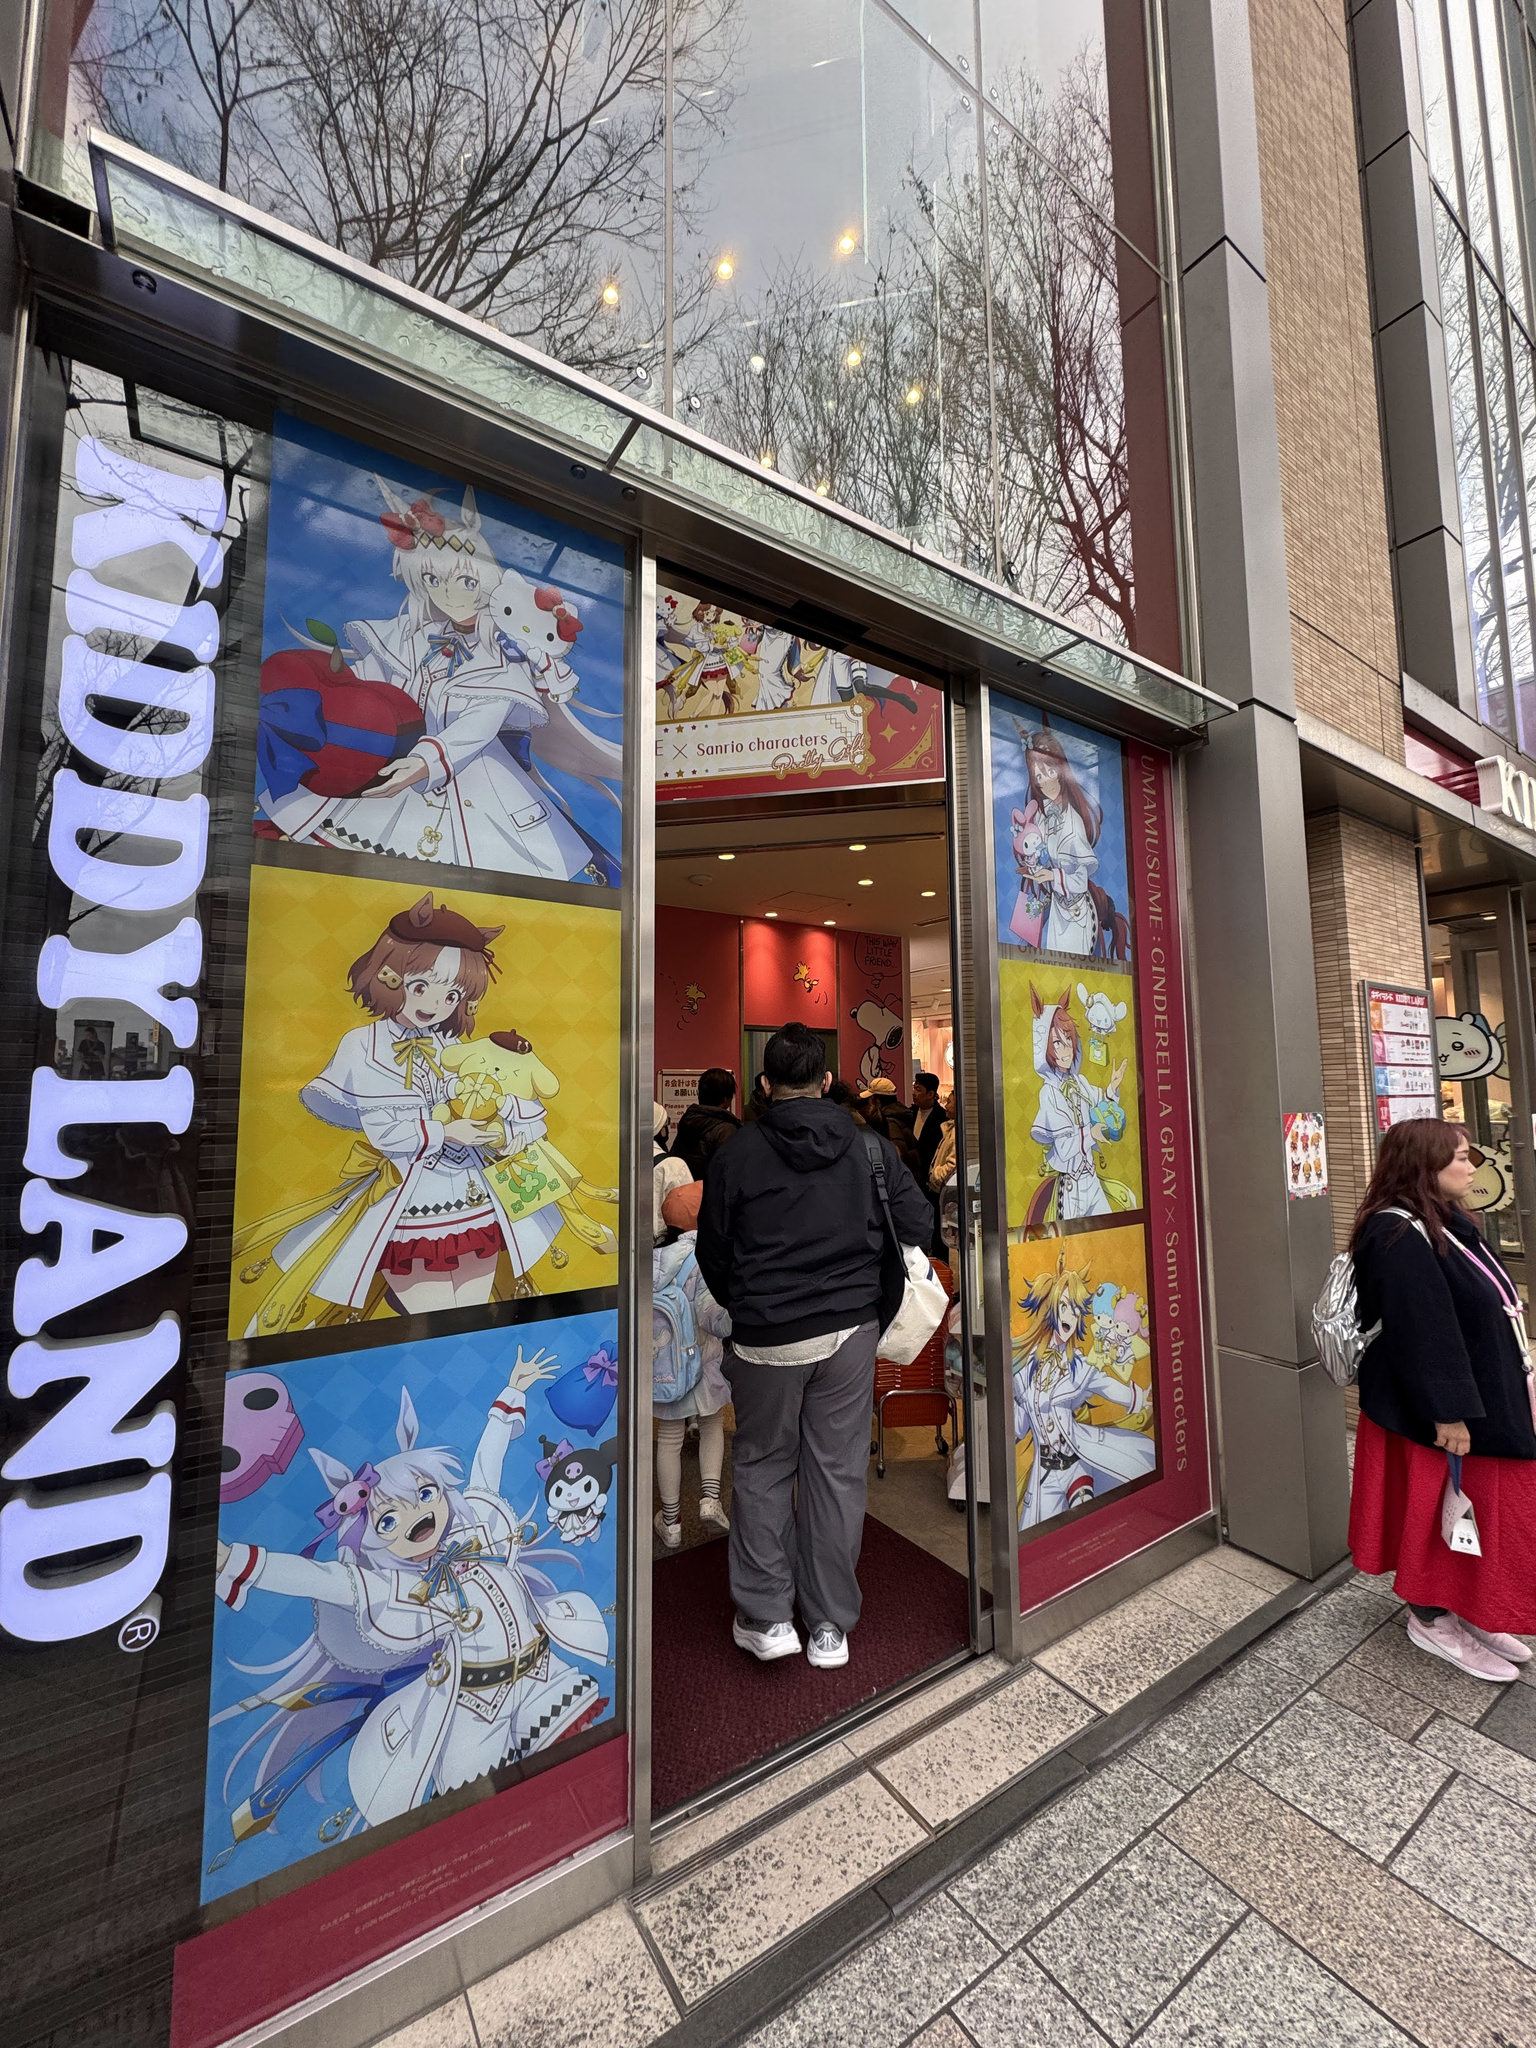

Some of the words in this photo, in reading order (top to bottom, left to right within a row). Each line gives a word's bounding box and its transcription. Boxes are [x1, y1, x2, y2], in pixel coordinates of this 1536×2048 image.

[697, 740, 744, 757] Sanrio
[748, 733, 828, 752] characters
[771, 749, 825, 774] Pretty
[828, 733, 866, 763] Gift
[1141, 755, 1164, 930] UMAMUSUME
[864, 936, 881, 946] THIS
[883, 938, 898, 947] WAY
[867, 946, 893, 957] LITTLE
[1151, 947, 1174, 1118] CINDERELLA
[665, 1079, 698, 1088] お会計は各
[1160, 1126, 1178, 1199] GRAY
[1165, 1231, 1182, 1318] Sanrio
[1170, 1326, 1188, 1472] characters
